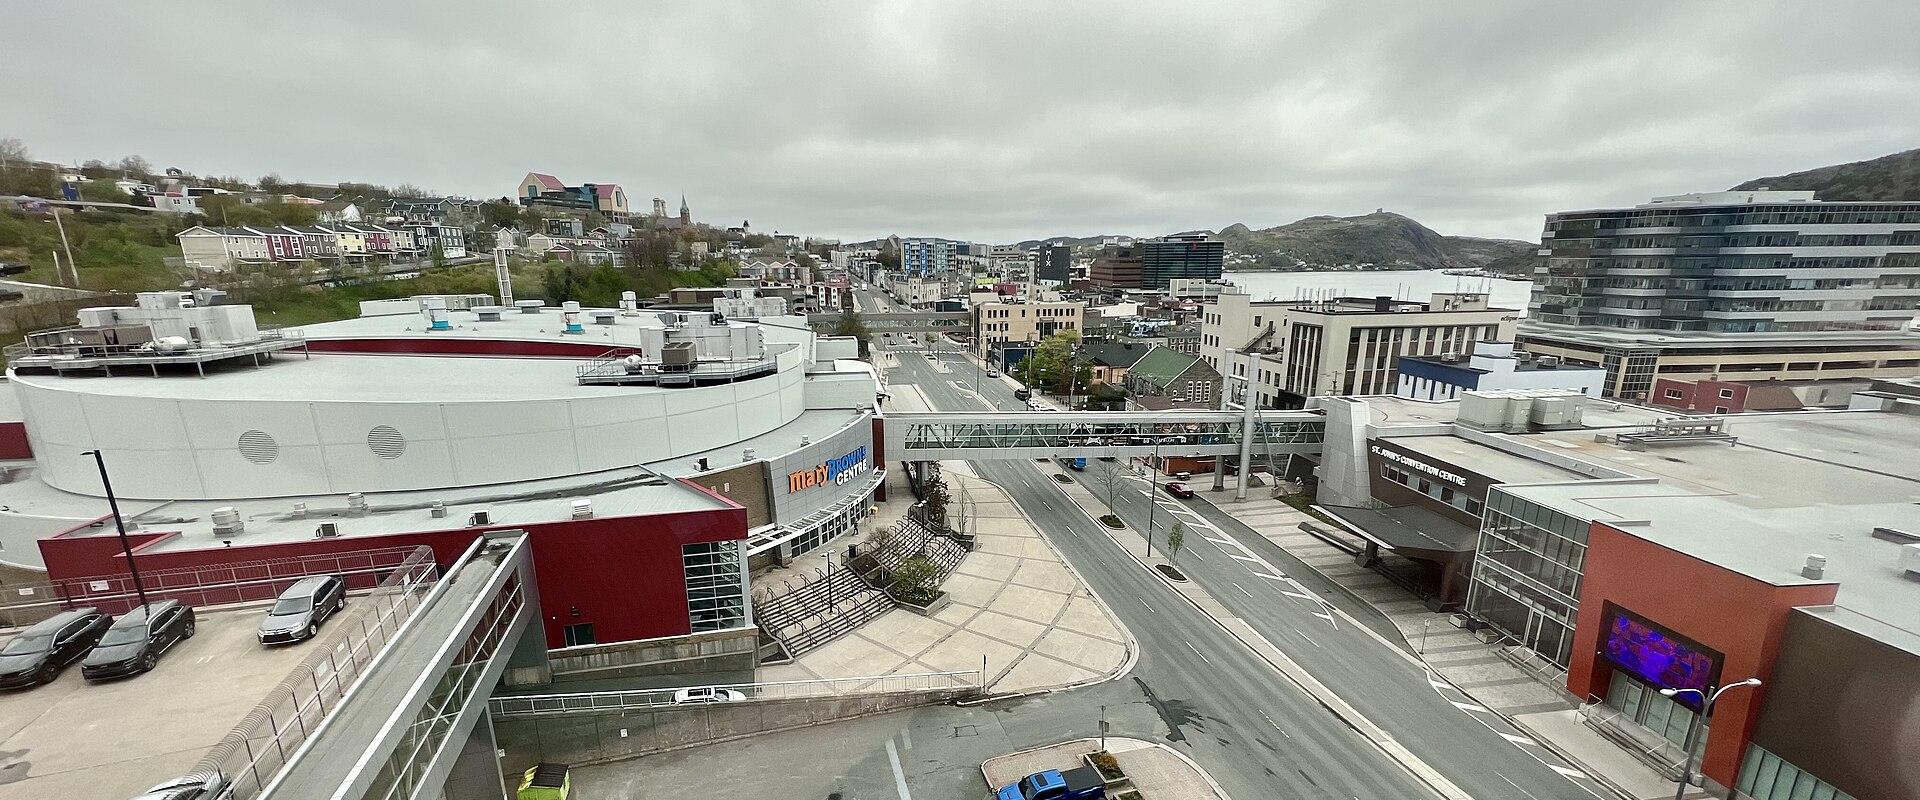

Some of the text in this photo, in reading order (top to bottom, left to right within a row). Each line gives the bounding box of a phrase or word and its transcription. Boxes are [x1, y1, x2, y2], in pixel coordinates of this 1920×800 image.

[835, 459, 867, 486] CENTRE
[1371, 445, 1381, 454] ST.
[1400, 456, 1440, 476] CONVENTION
[1438, 470, 1467, 487] CENTRE
